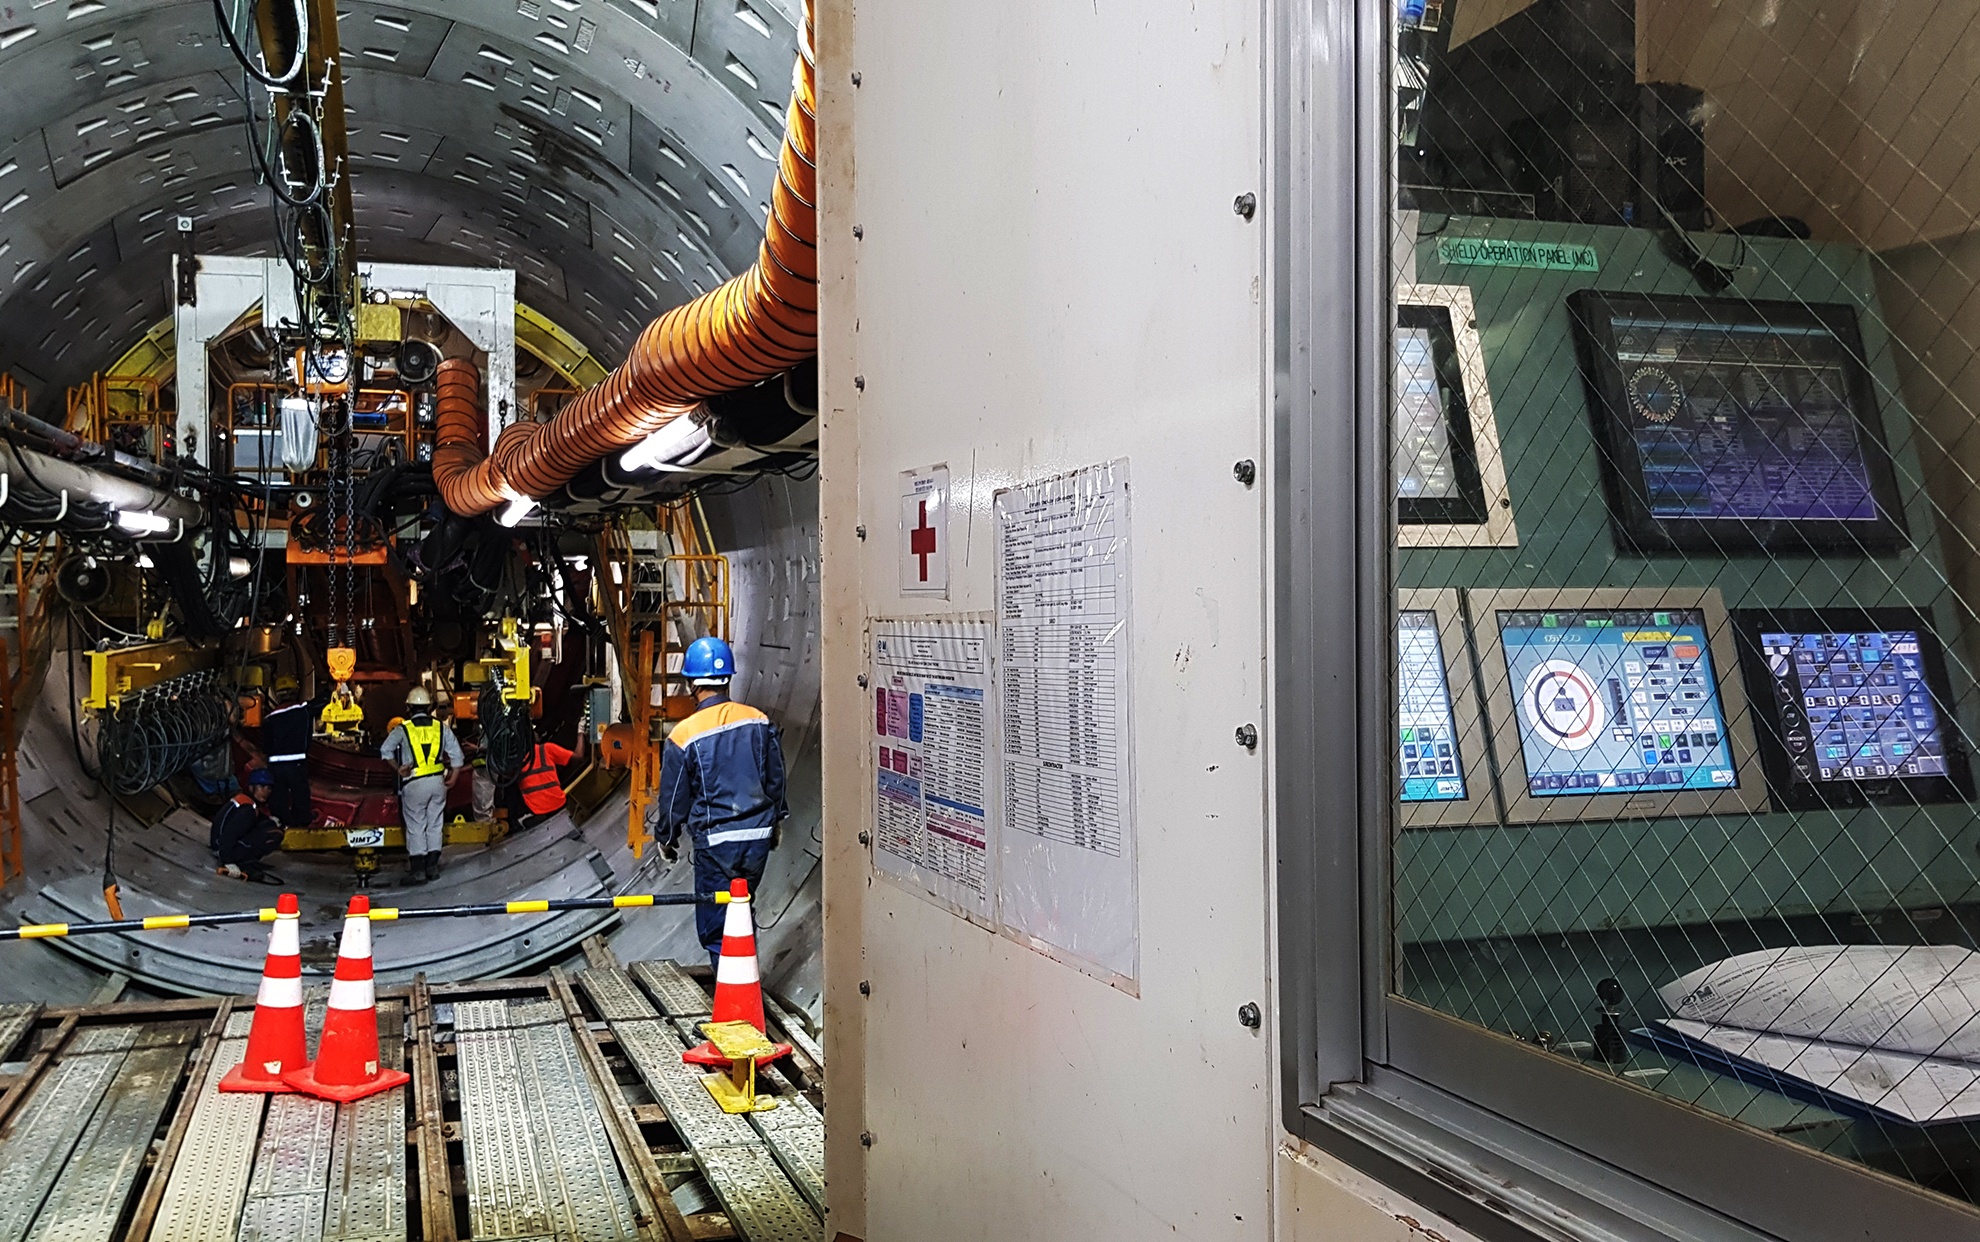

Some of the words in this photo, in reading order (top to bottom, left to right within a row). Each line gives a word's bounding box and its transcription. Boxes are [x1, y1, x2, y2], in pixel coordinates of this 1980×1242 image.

[1665, 156, 1688, 166] APC
[1442, 243, 1477, 259] SHIELD
[1479, 245, 1538, 263] OPERATION
[1539, 248, 1571, 264] PANEL
[1572, 250, 1595, 267] (MC)
[349, 836, 372, 844] JIMT
